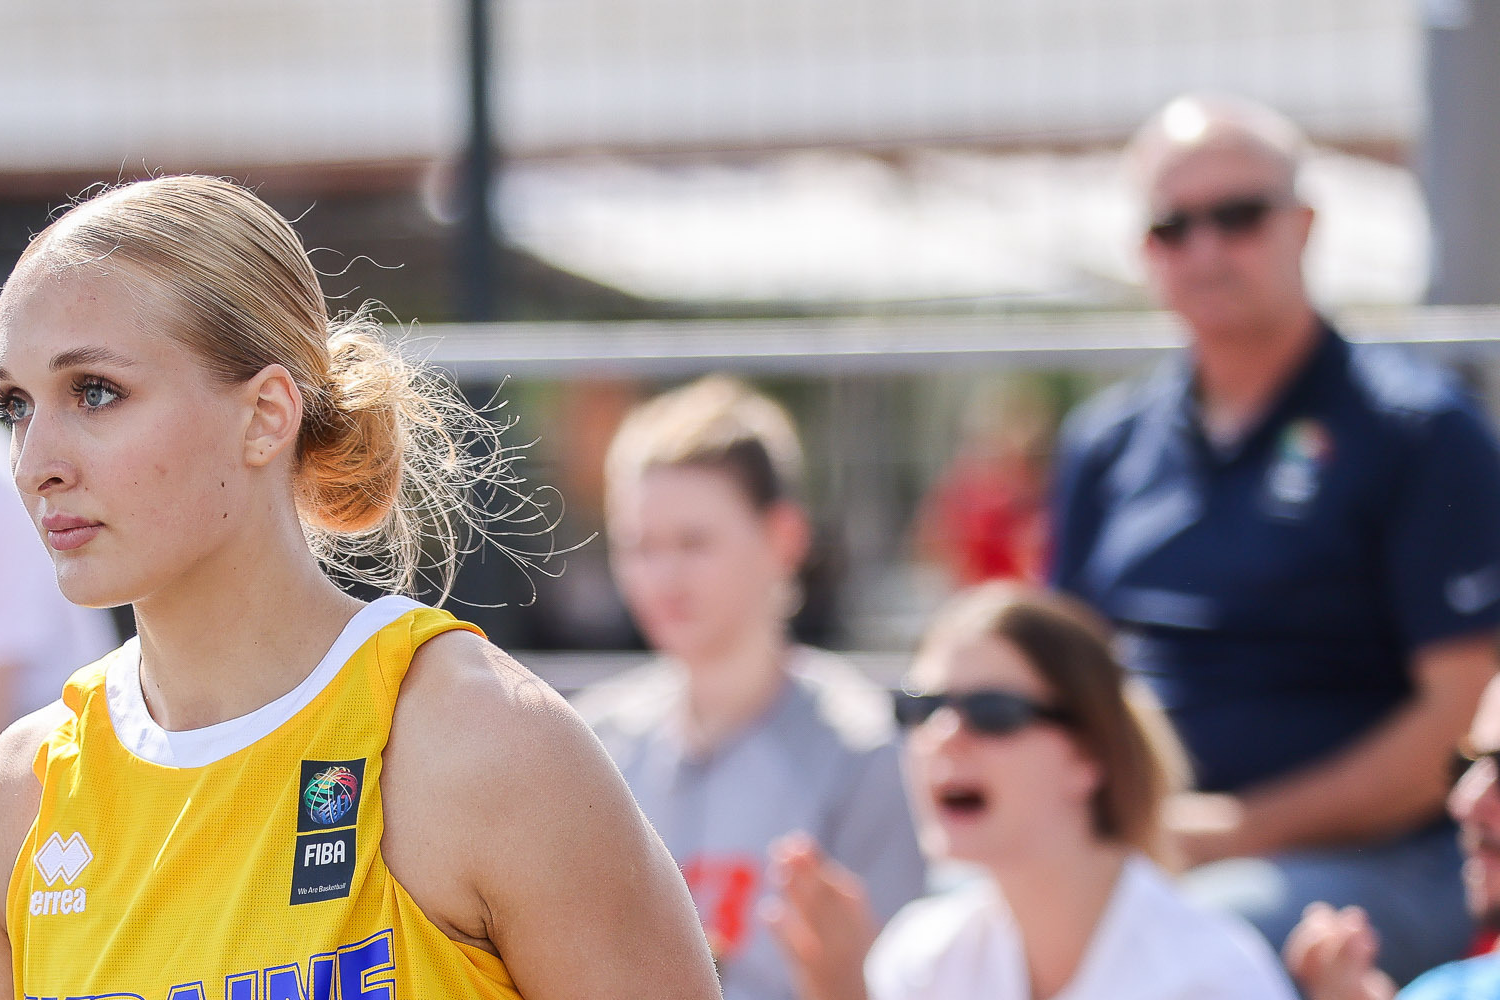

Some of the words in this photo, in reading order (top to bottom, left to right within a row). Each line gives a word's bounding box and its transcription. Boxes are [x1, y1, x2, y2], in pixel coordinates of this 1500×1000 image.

[304, 840, 346, 867] FIBA
[297, 887, 308, 896] We
[308, 886, 319, 894] Are
